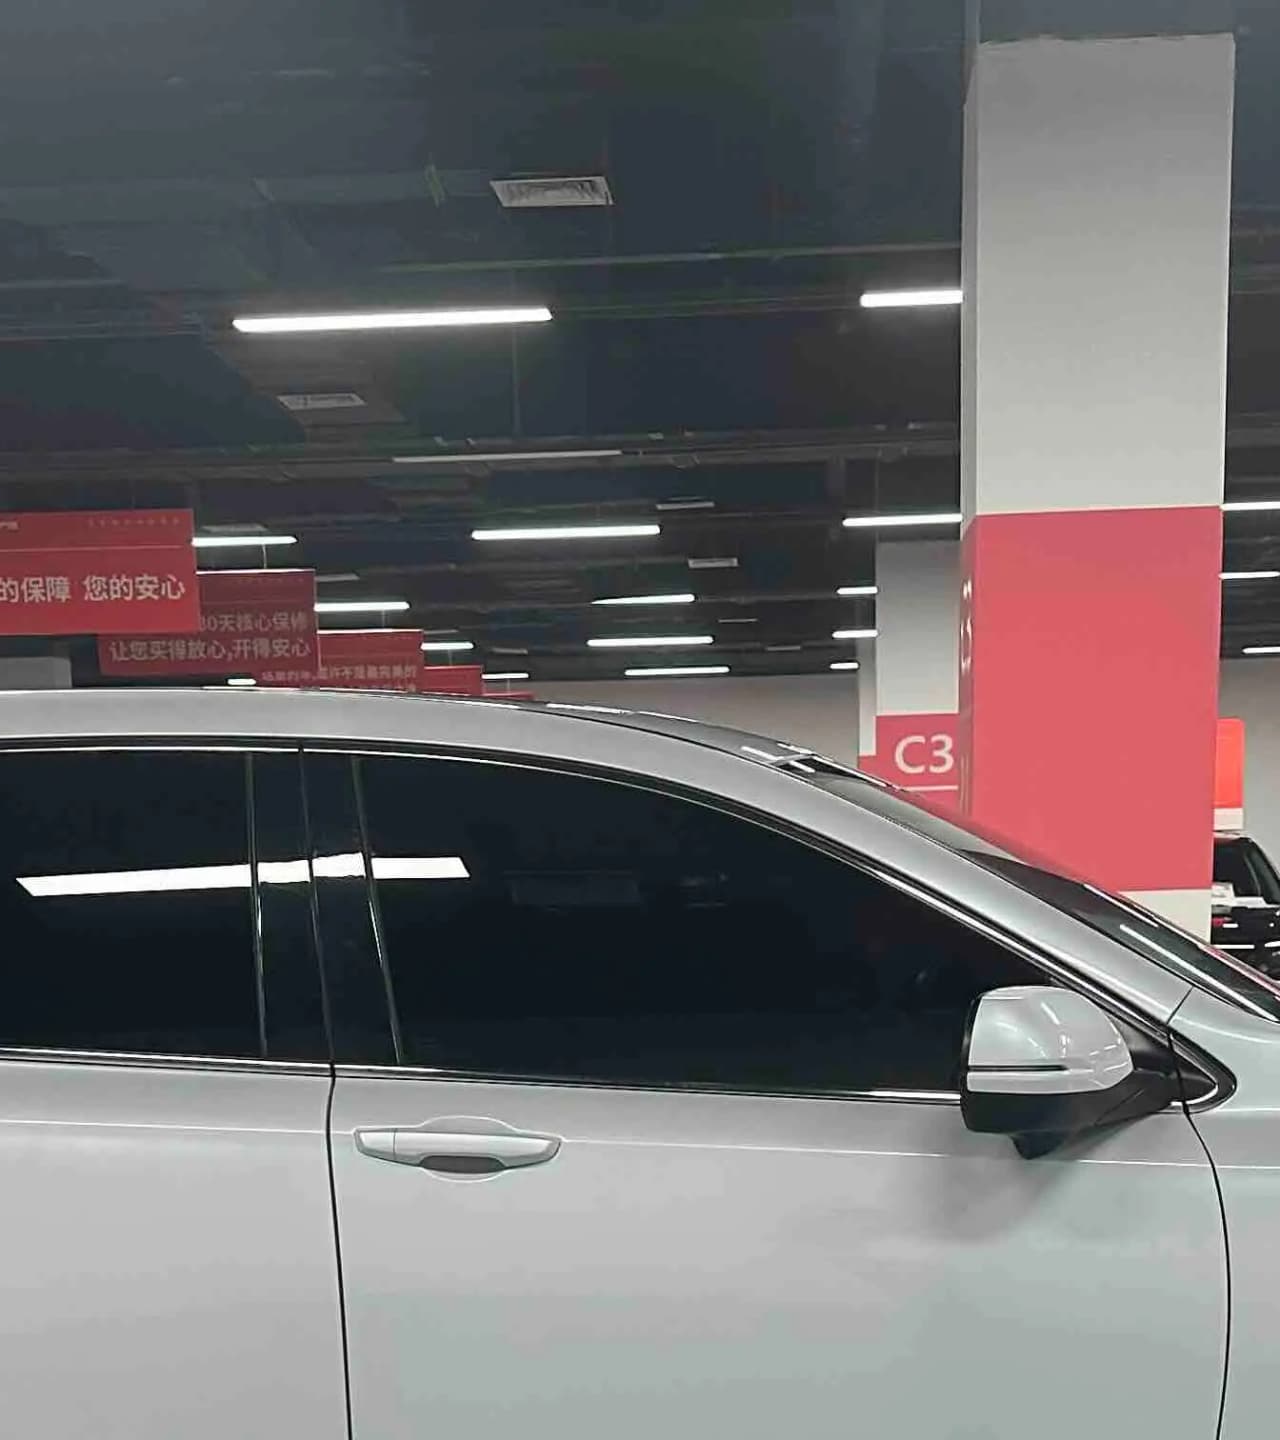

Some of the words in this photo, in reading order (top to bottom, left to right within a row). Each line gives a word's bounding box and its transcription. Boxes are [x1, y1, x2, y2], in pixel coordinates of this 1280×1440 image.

[83, 574, 186, 601] 您的安心
[893, 733, 955, 775] C3
